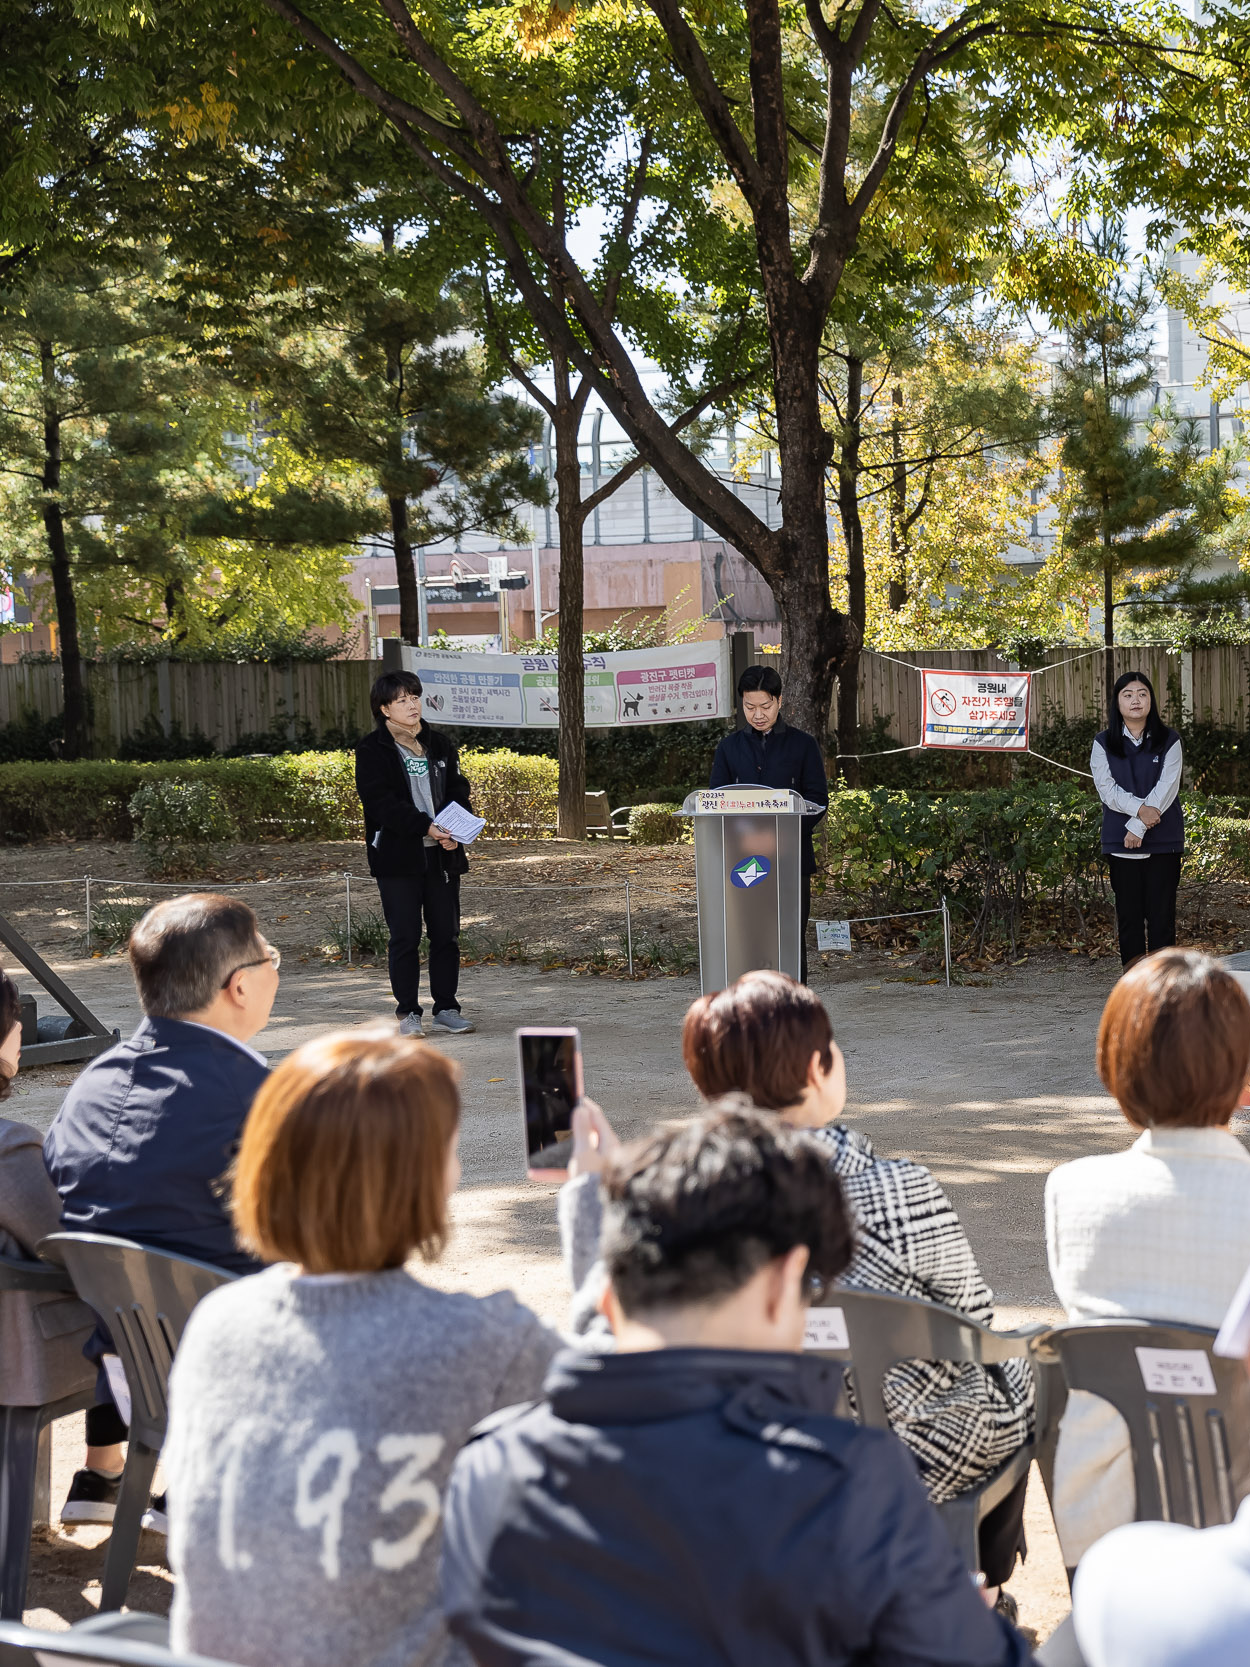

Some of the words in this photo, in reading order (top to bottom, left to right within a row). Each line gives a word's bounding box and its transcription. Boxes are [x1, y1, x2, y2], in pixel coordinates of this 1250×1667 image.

[460, 674, 476, 685] 공원
[640, 670, 667, 682] 광진구
[669, 668, 696, 680] 펫티켓
[978, 683, 1007, 694] 공원내
[962, 696, 990, 707] 자전거
[994, 696, 1023, 707] 주행을
[969, 711, 1017, 720] 삼가주세요
[702, 800, 717, 810] 광진
